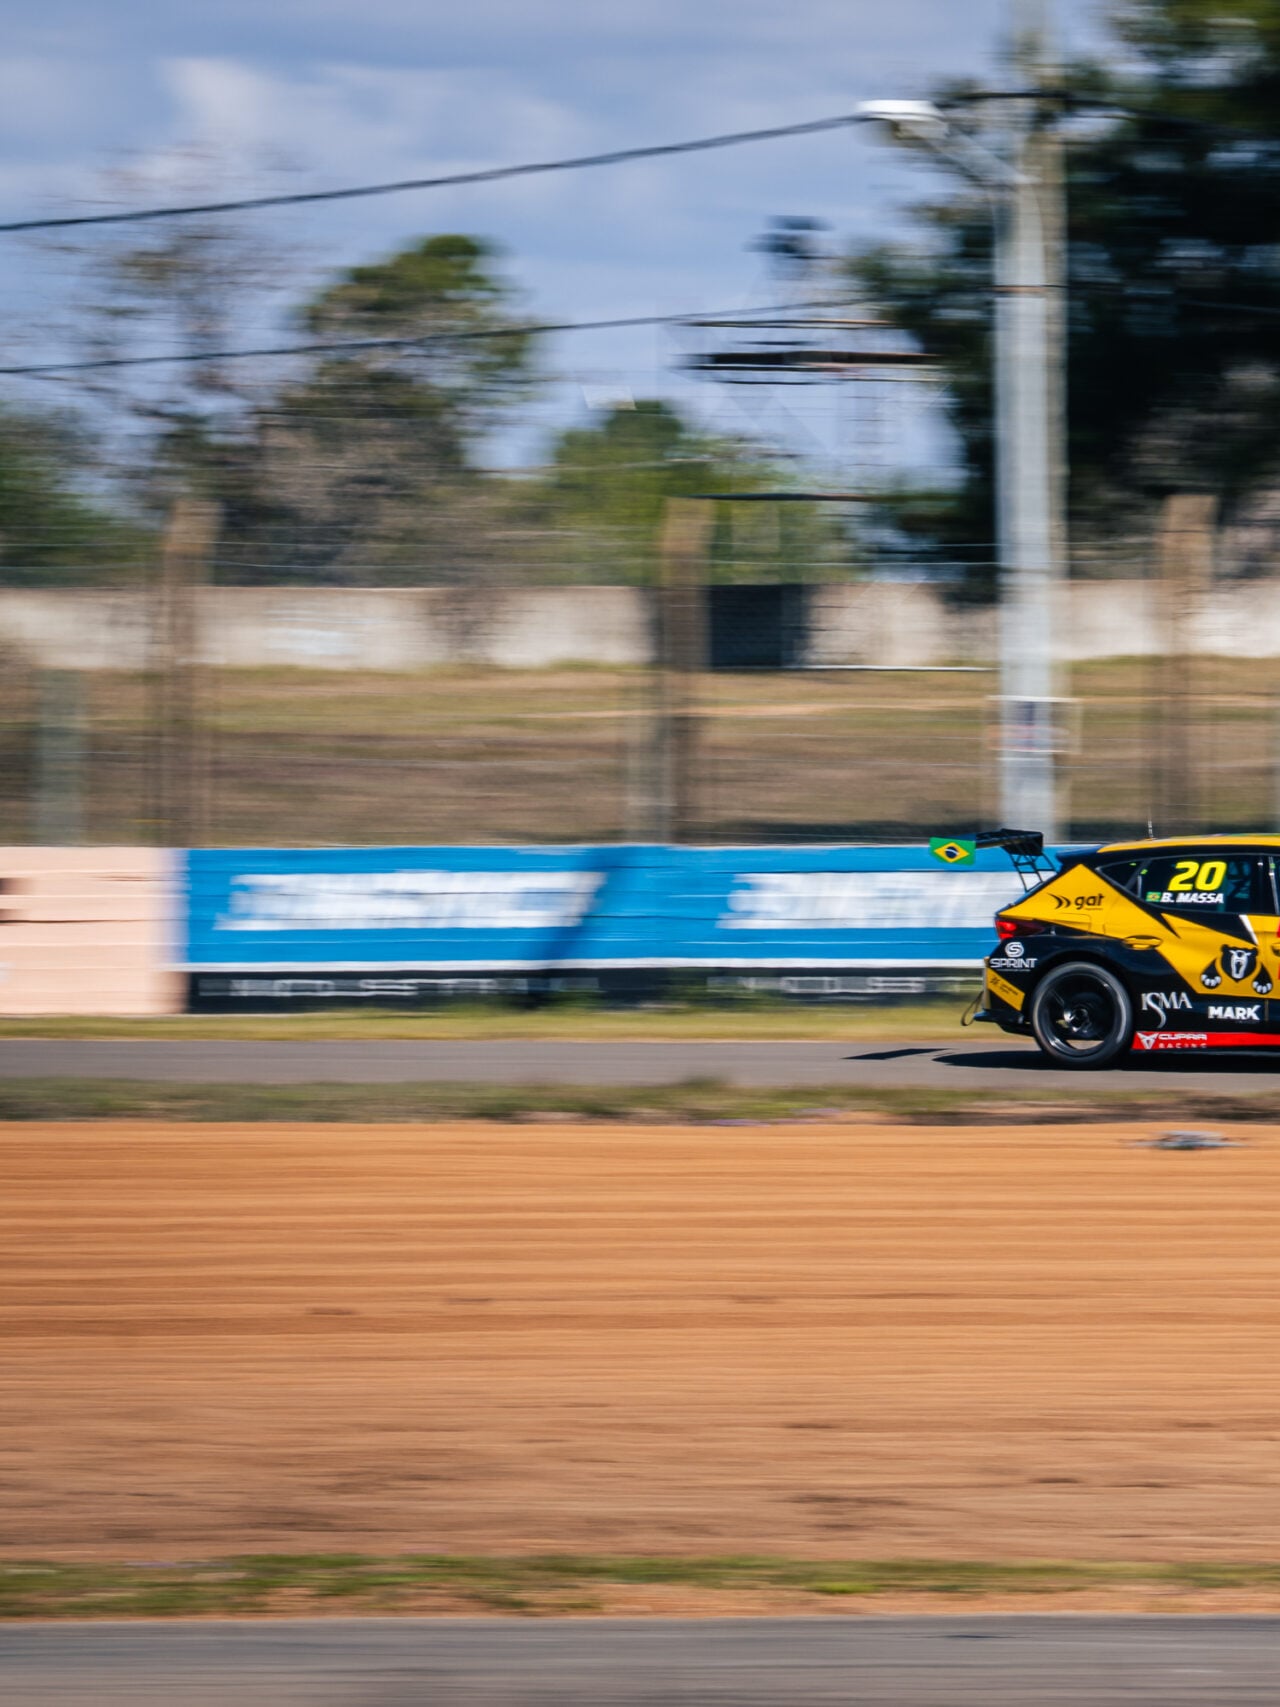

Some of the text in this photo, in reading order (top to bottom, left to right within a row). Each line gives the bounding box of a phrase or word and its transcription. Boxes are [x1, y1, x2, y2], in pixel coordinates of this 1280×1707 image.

[1167, 861, 1227, 891] 20
[1160, 892, 1224, 904] B. MASSA
[989, 957, 1038, 969] SPRINT
[1207, 1004, 1261, 1021] MARK
